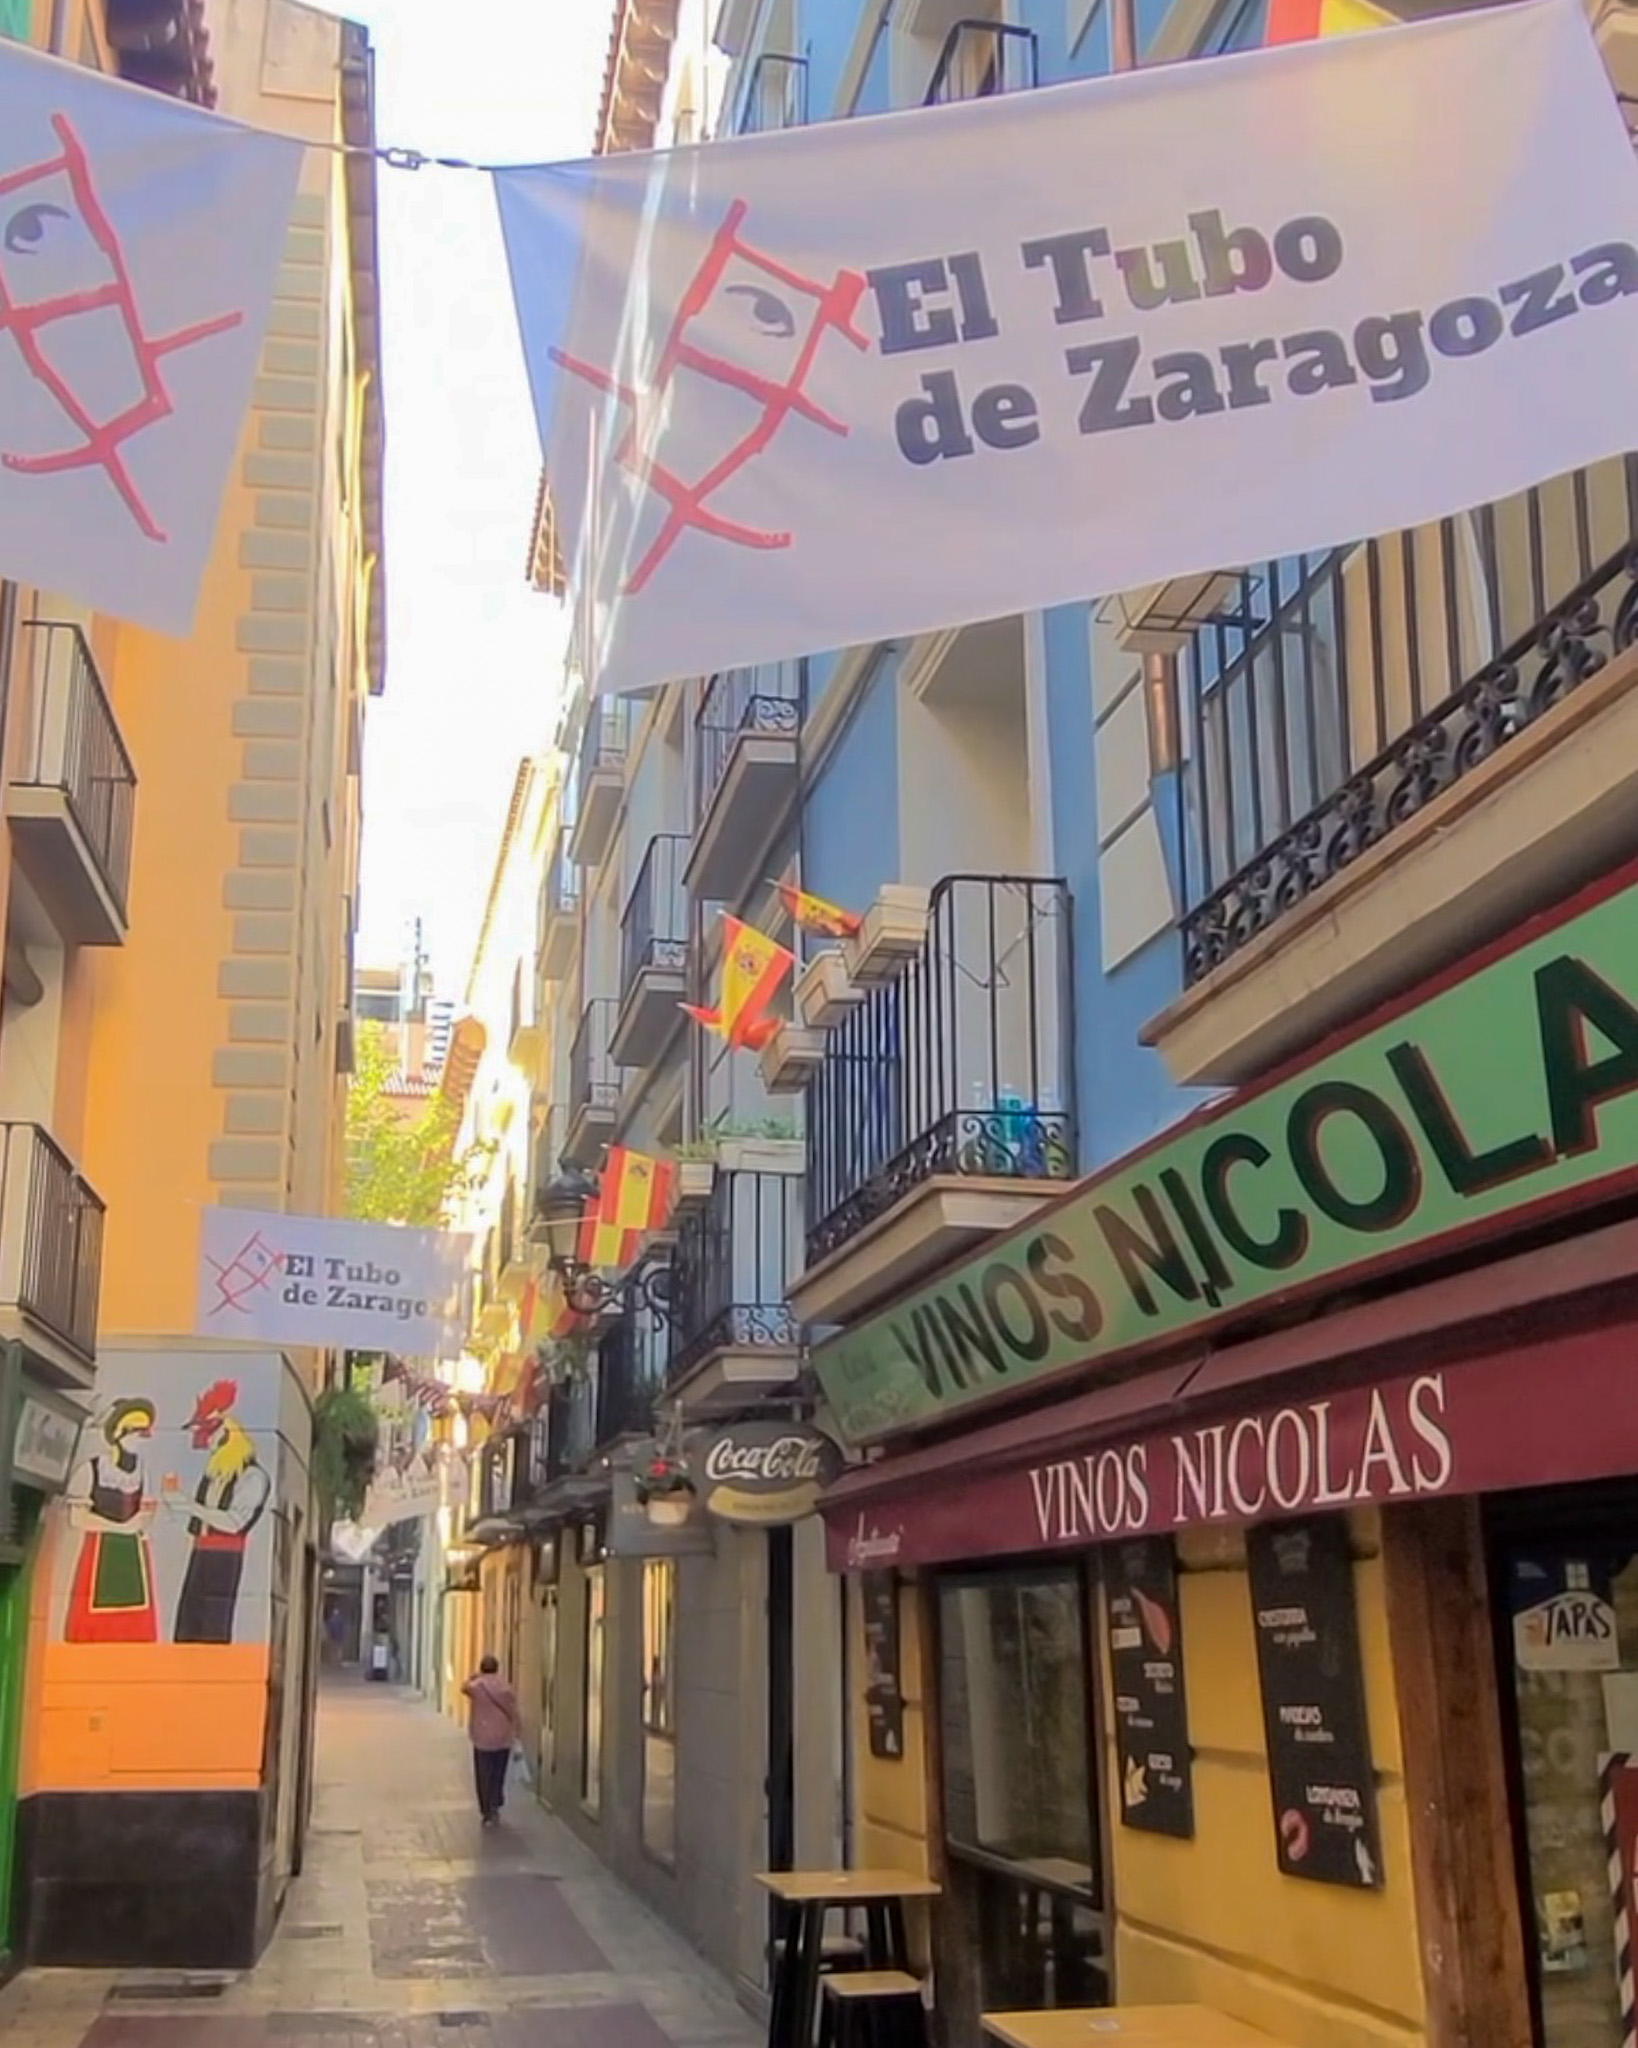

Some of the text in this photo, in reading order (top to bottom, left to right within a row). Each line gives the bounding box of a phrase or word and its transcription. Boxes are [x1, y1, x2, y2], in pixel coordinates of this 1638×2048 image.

[867, 208, 1344, 356] El Tubo
[894, 241, 1638, 466] de Zaragoza
[282, 1283, 319, 1306] de
[284, 1253, 402, 1286] El Tubo
[892, 1232, 1106, 1399] VINOS
[1028, 1443, 1150, 1542] VINOS
[1172, 1373, 1452, 1523] NICOLAS
[1541, 1601, 1611, 1646] TAPAS
